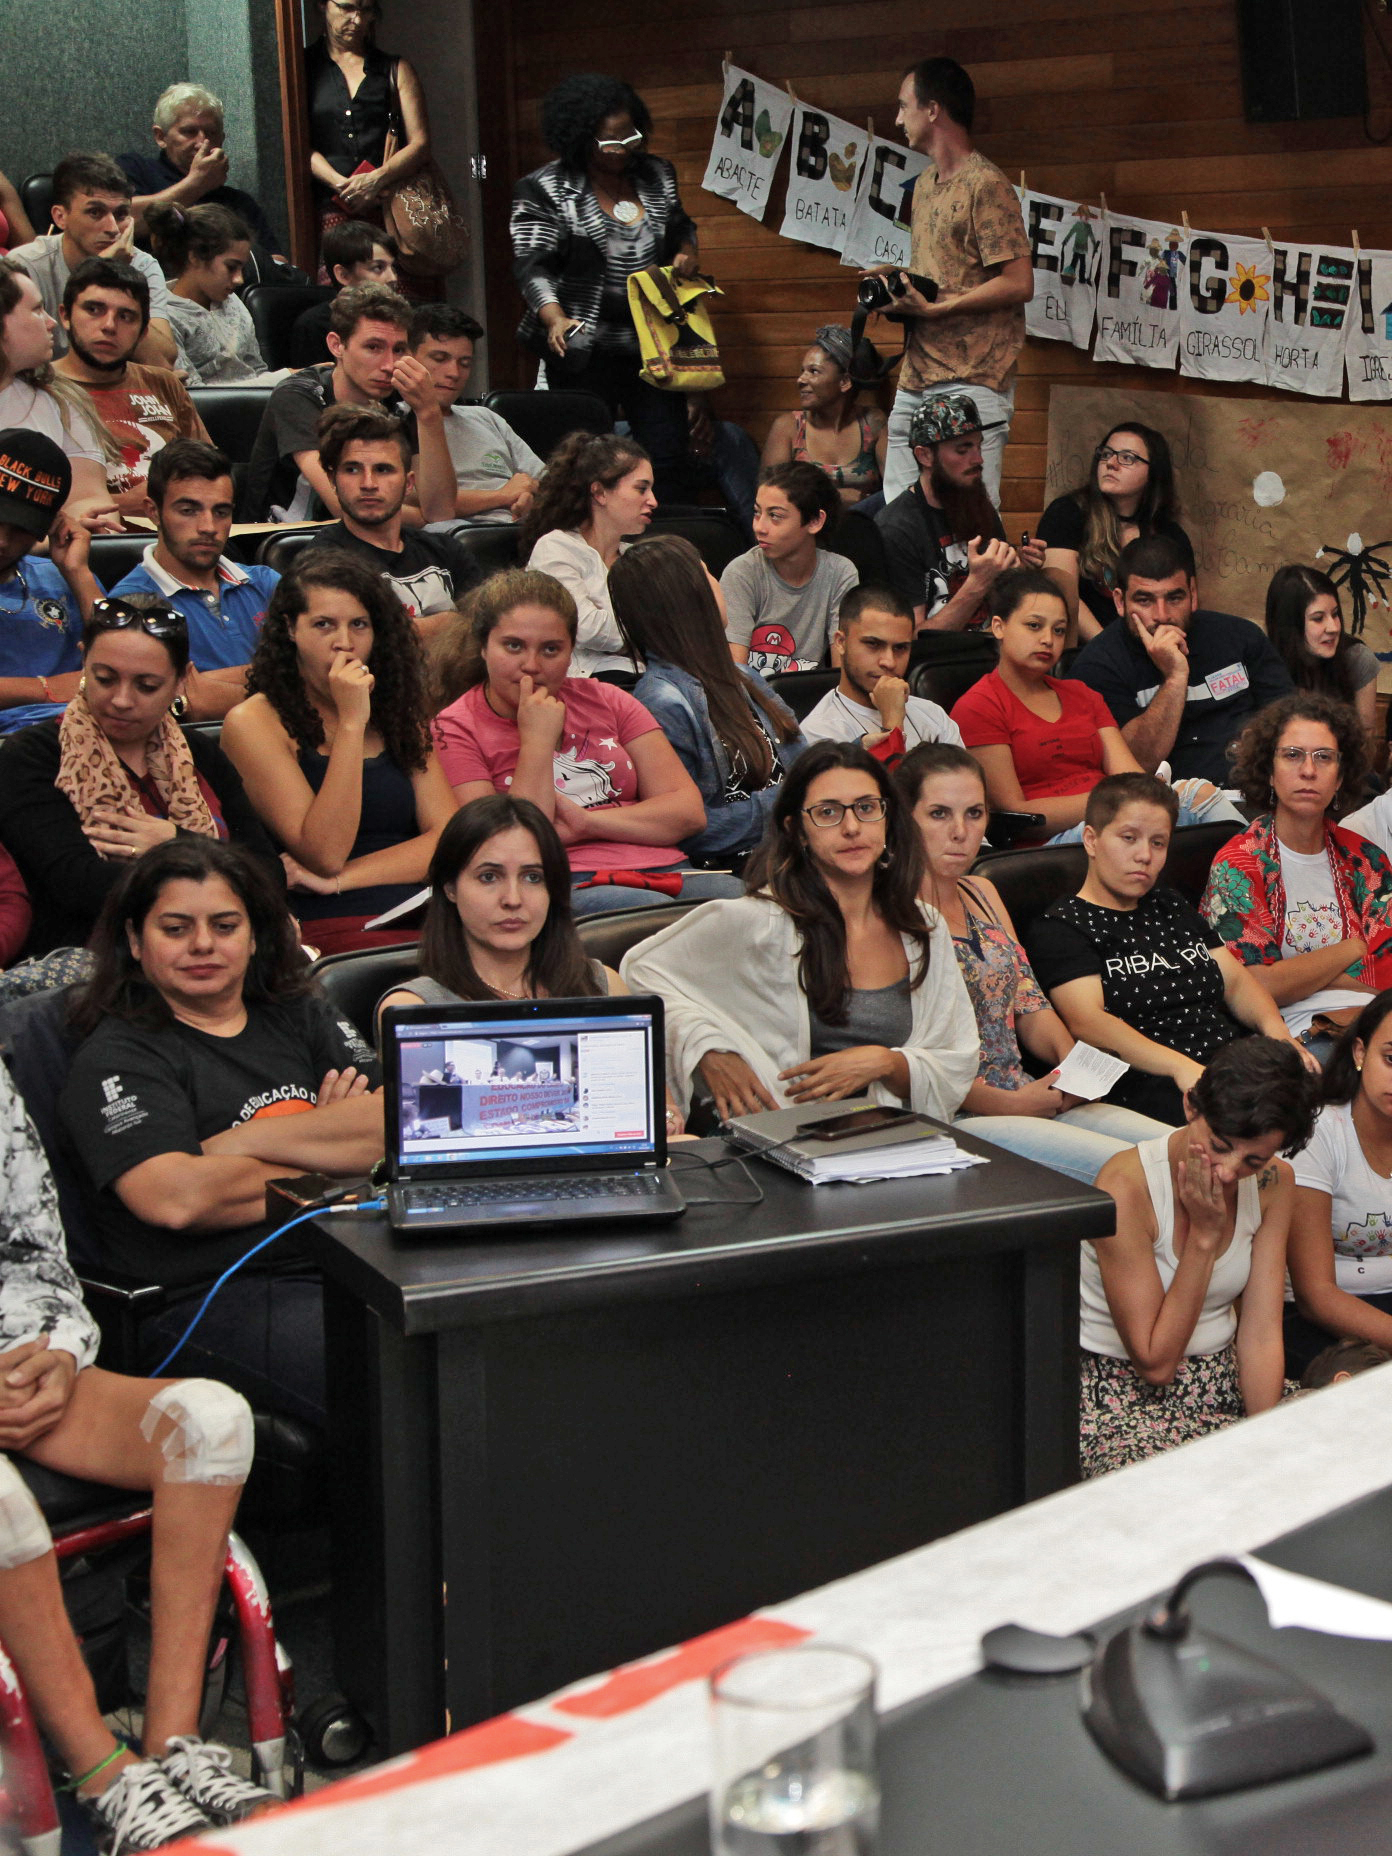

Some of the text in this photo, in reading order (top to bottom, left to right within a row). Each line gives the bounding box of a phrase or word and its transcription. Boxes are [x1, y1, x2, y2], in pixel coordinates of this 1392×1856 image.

[720, 79, 756, 152] A
[796, 111, 830, 181] B
[795, 198, 847, 229] BATATA
[874, 235, 905, 267] CASA
[1029, 200, 1064, 273] E
[1107, 226, 1147, 298] F
[1189, 238, 1229, 314] G
[1272, 248, 1313, 326] H
[1358, 258, 1375, 334] I
[1045, 295, 1067, 321] EU
[1101, 315, 1168, 350] FAMÍLIA
[1186, 329, 1261, 363] GIRASSOL
[1274, 345, 1319, 370] HORTA
[0, 471, 21, 492] EW
[1210, 671, 1246, 693] FATAL
[240, 1102, 256, 1121] DE
[479, 1093, 518, 1107] DIREITO
[519, 1090, 543, 1101] NOSSO
[479, 1105, 519, 1121] ESTADO
